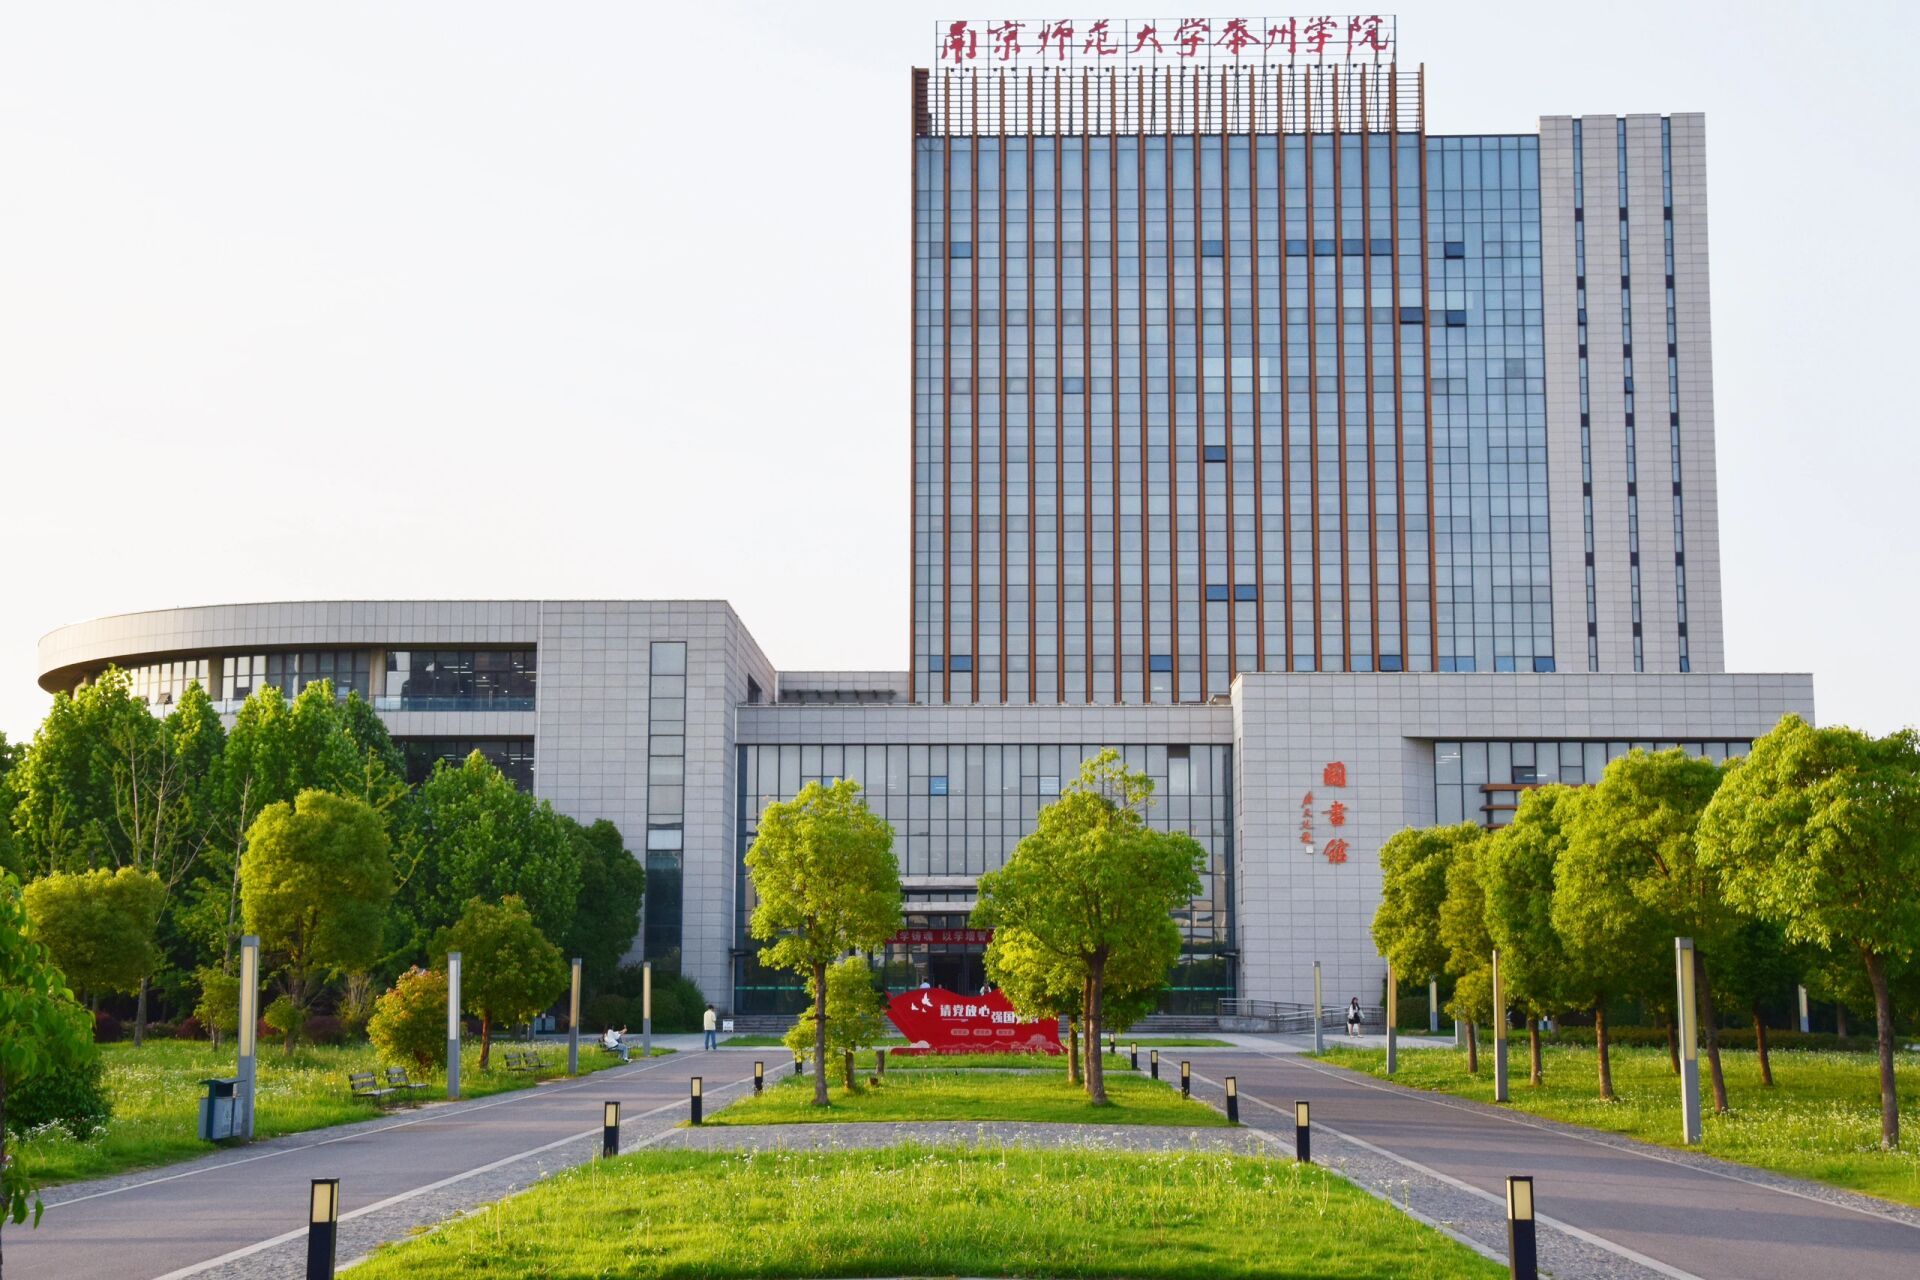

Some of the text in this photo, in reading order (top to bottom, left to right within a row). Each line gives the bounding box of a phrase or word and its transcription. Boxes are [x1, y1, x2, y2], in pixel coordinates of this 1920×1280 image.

[941, 15, 1389, 64] 南京师范大学泰州学院
[940, 1004, 990, 1017] 请党放心
[991, 1011, 1039, 1024] 强国
